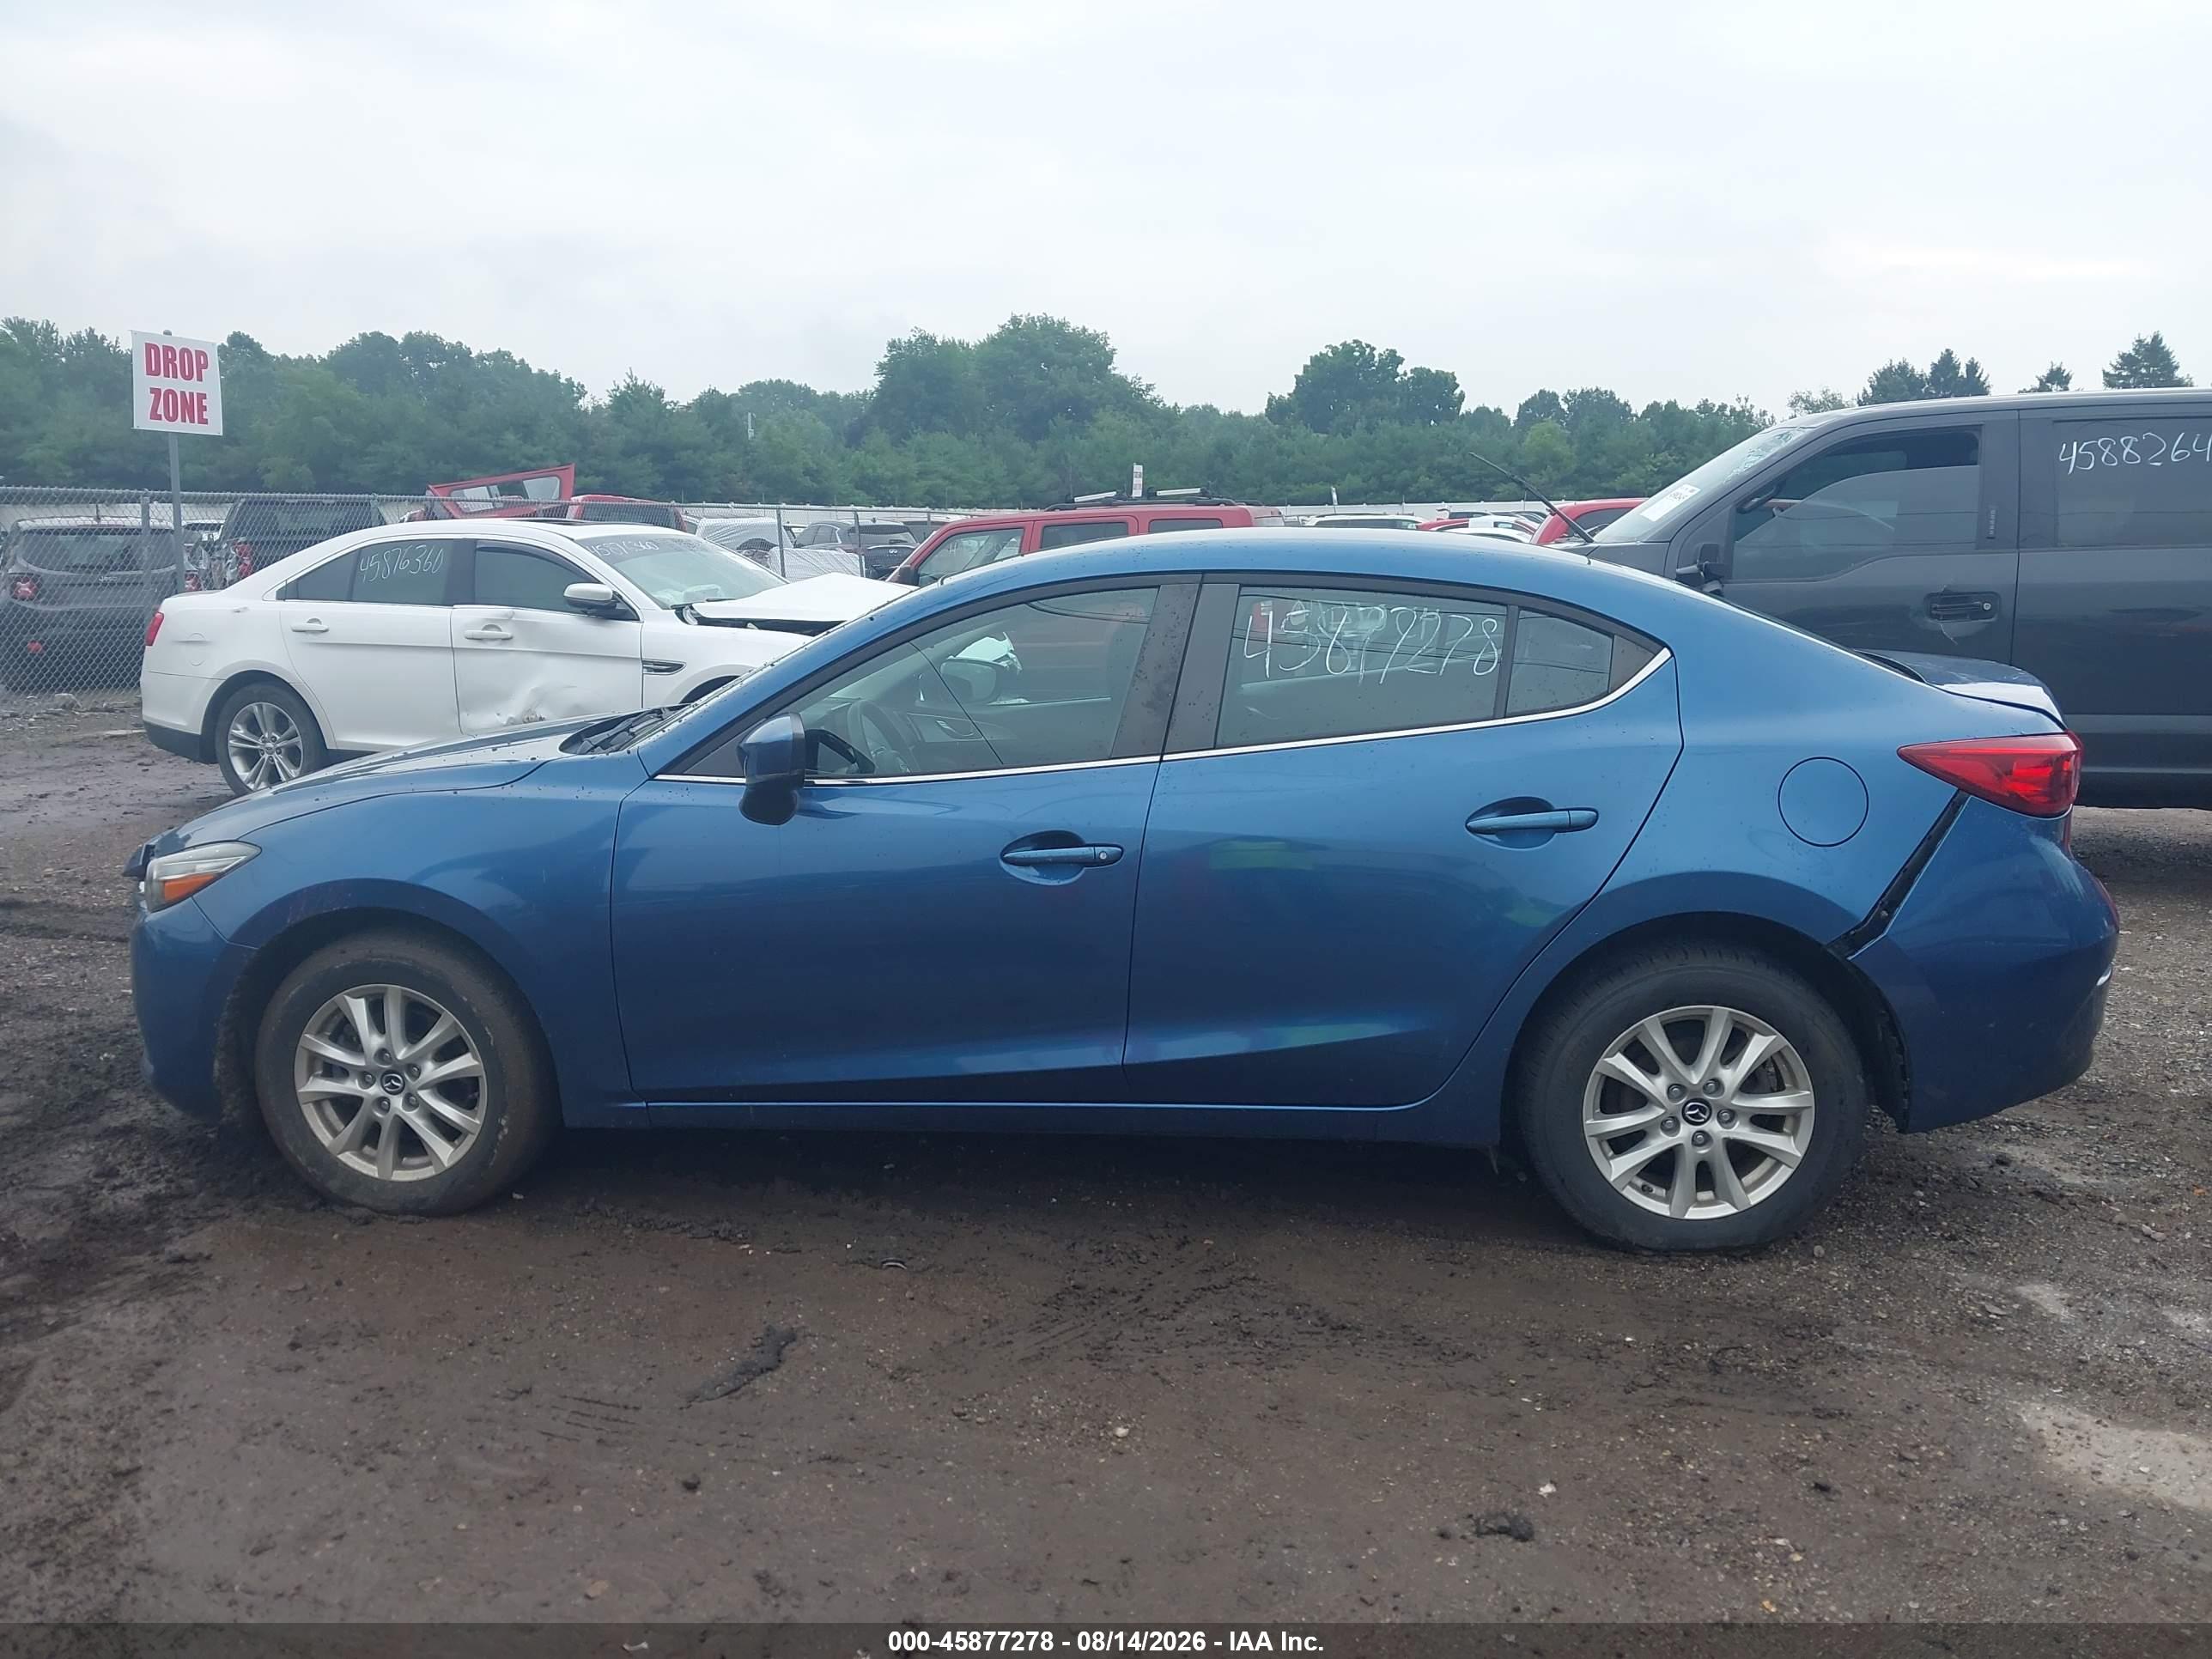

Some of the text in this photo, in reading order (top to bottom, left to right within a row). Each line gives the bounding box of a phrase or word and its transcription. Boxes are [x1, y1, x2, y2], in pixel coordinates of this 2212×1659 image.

[144, 342, 209, 382] DROP
[149, 387, 209, 425] ZONE
[360, 544, 444, 583] 45876360
[1244, 605, 1498, 685] 45877278
